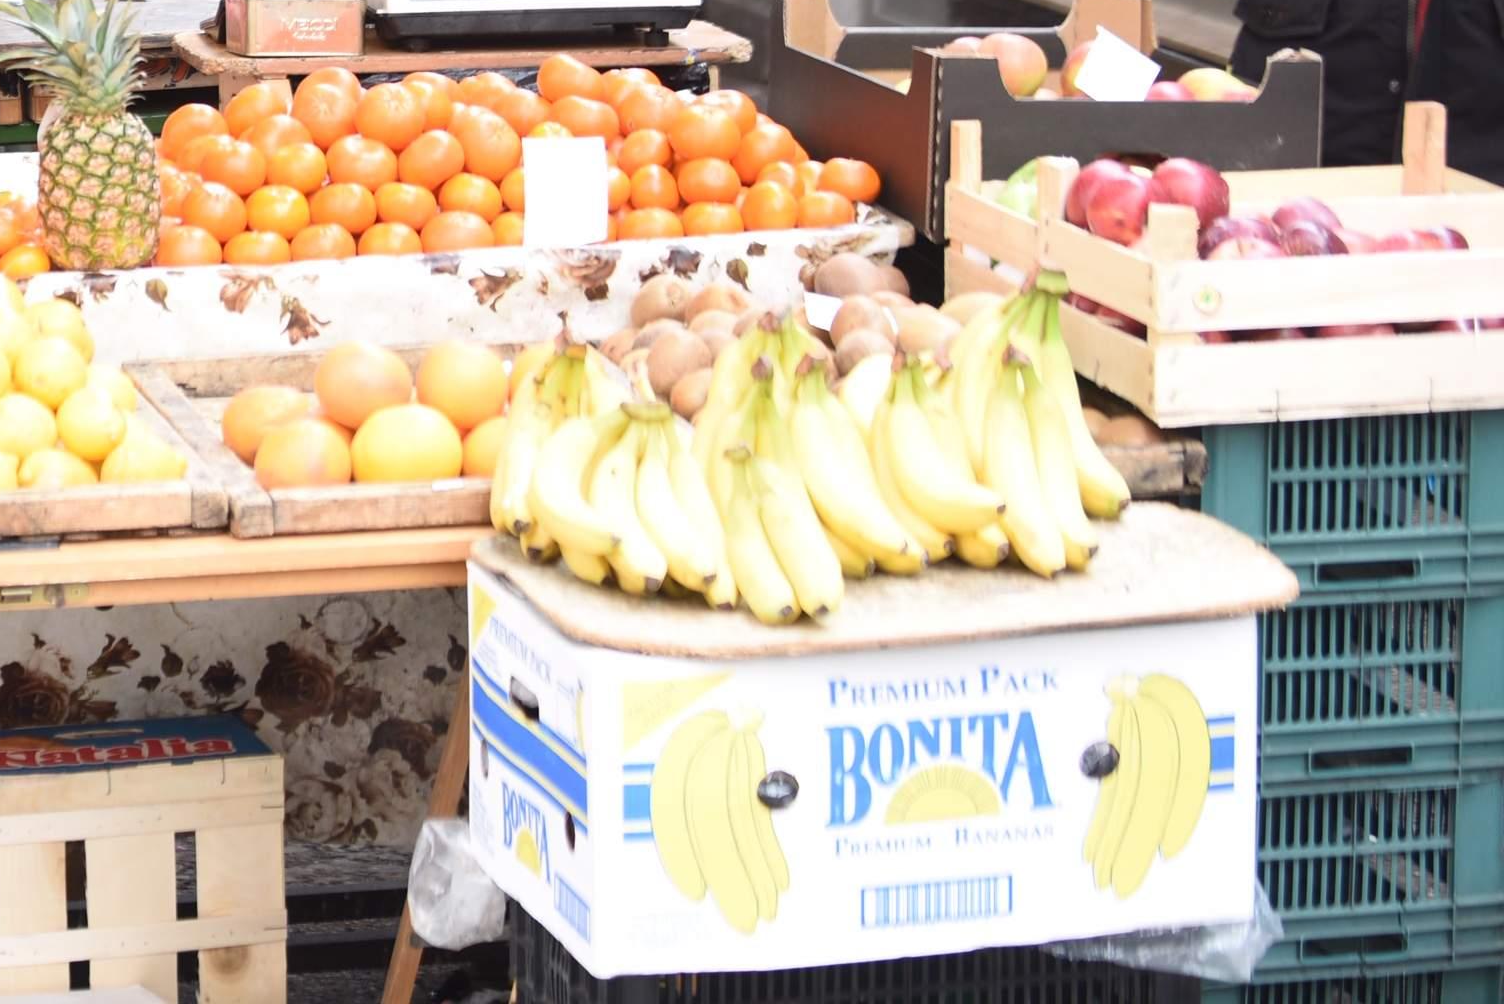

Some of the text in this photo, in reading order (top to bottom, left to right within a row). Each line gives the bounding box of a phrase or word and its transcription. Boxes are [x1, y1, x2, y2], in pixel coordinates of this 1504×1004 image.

[827, 663, 1059, 707] PREMIUM PACK
[825, 709, 1056, 830] BONITA
[501, 780, 552, 885] BONITA
[834, 834, 933, 857] PREMIUM
